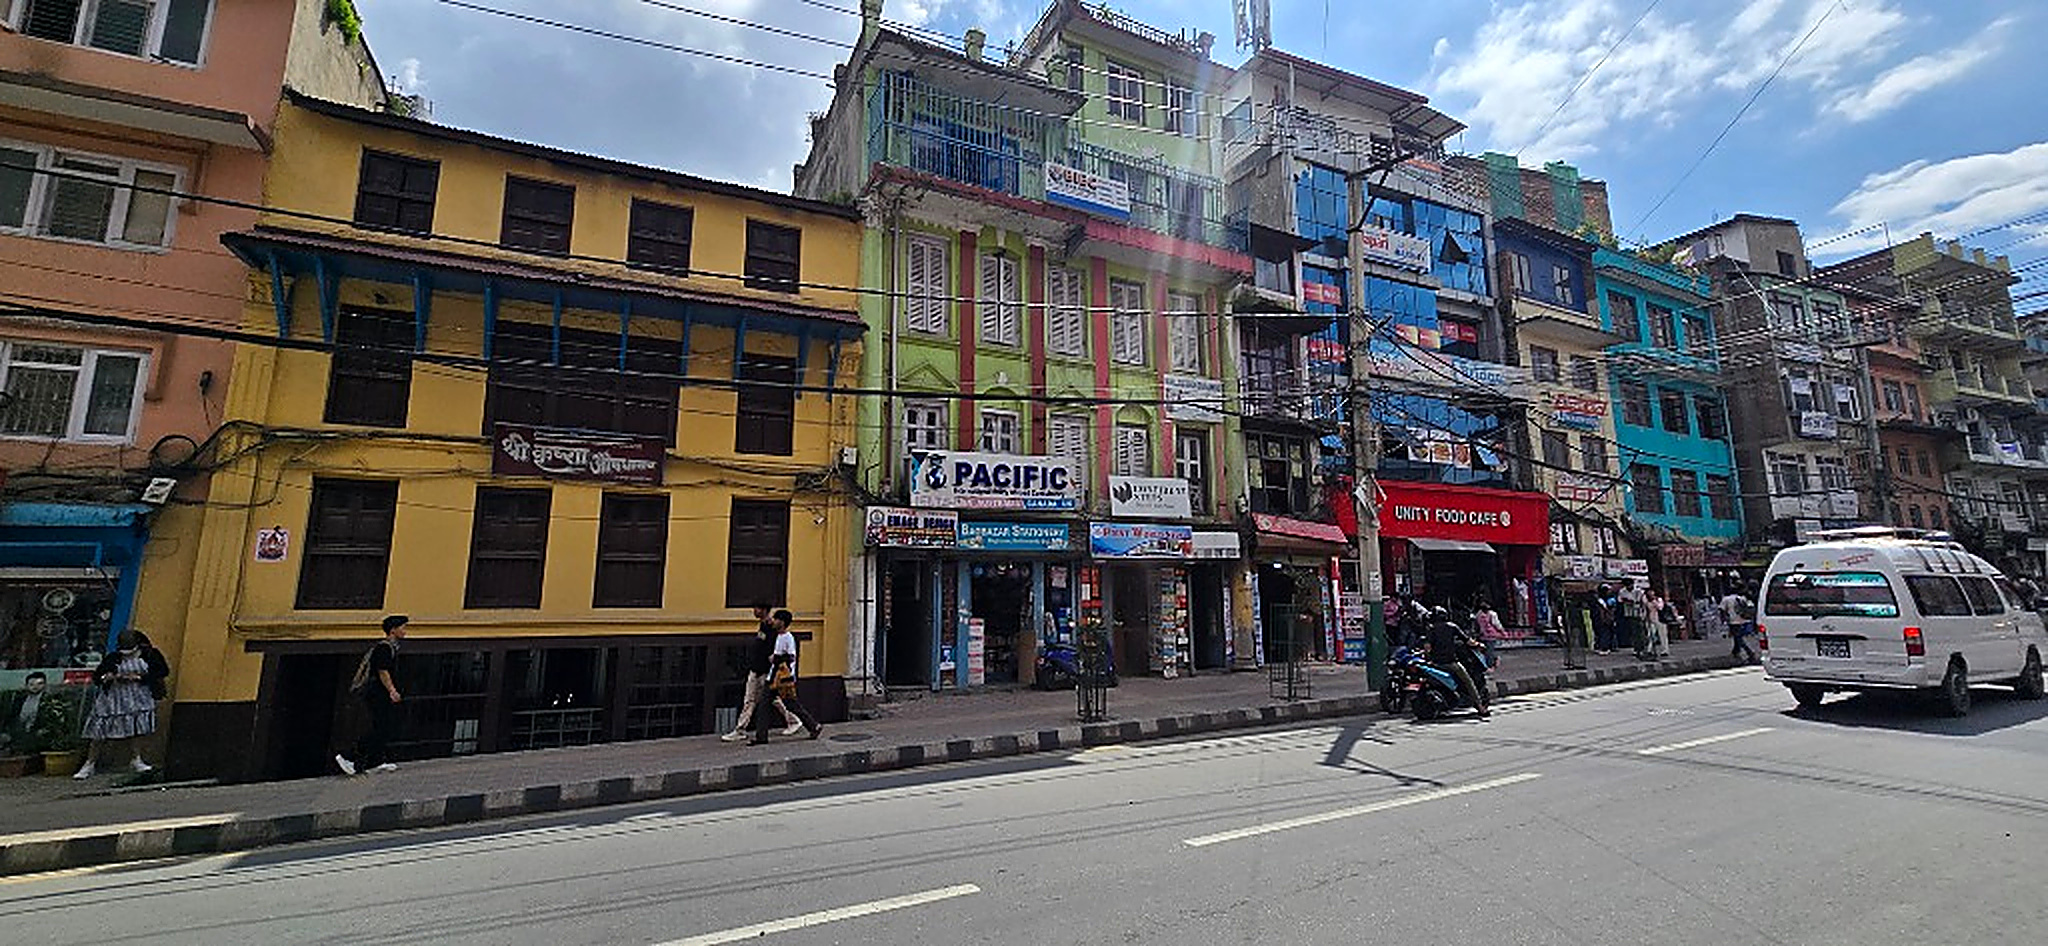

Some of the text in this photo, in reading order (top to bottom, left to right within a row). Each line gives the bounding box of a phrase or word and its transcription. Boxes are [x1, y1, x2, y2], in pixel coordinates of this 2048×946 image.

[501, 432, 531, 463] श्री
[953, 461, 1069, 490] PACIFIC
[1394, 505, 1498, 527] UNITY FOOD CAFE
